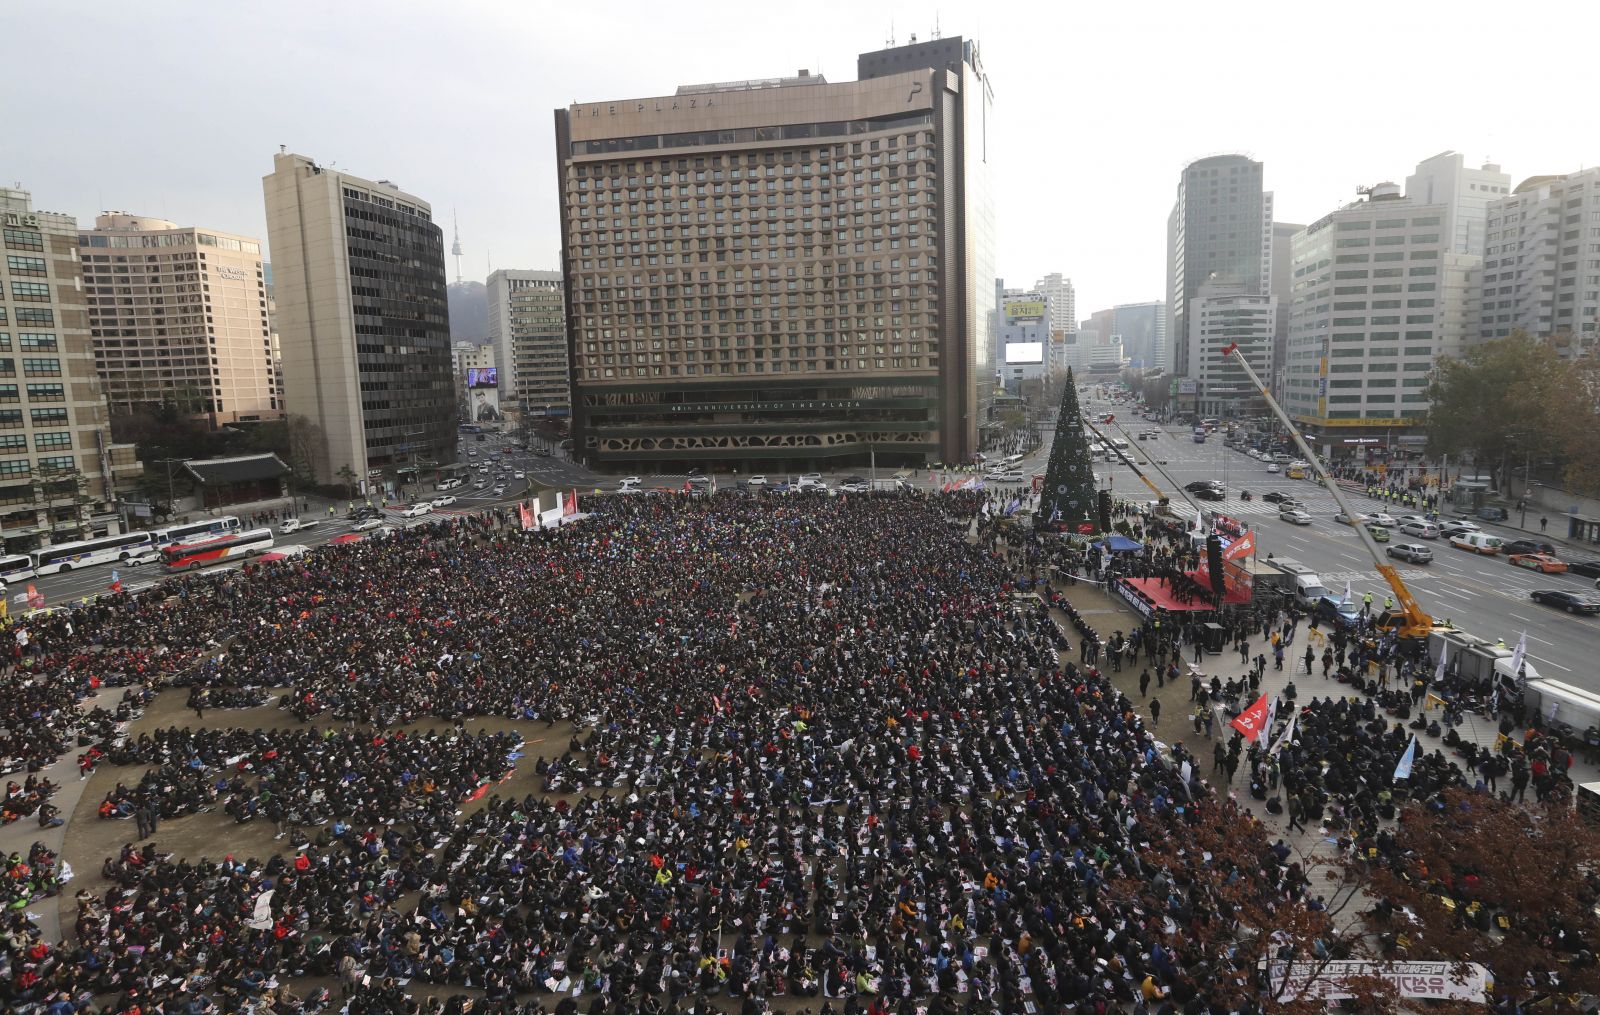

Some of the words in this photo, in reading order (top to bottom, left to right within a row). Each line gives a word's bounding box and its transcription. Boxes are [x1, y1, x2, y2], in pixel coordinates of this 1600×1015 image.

[575, 105, 616, 118] THE
[638, 98, 714, 113] PLAZA
[697, 403, 768, 411] ANNIVERSARY
